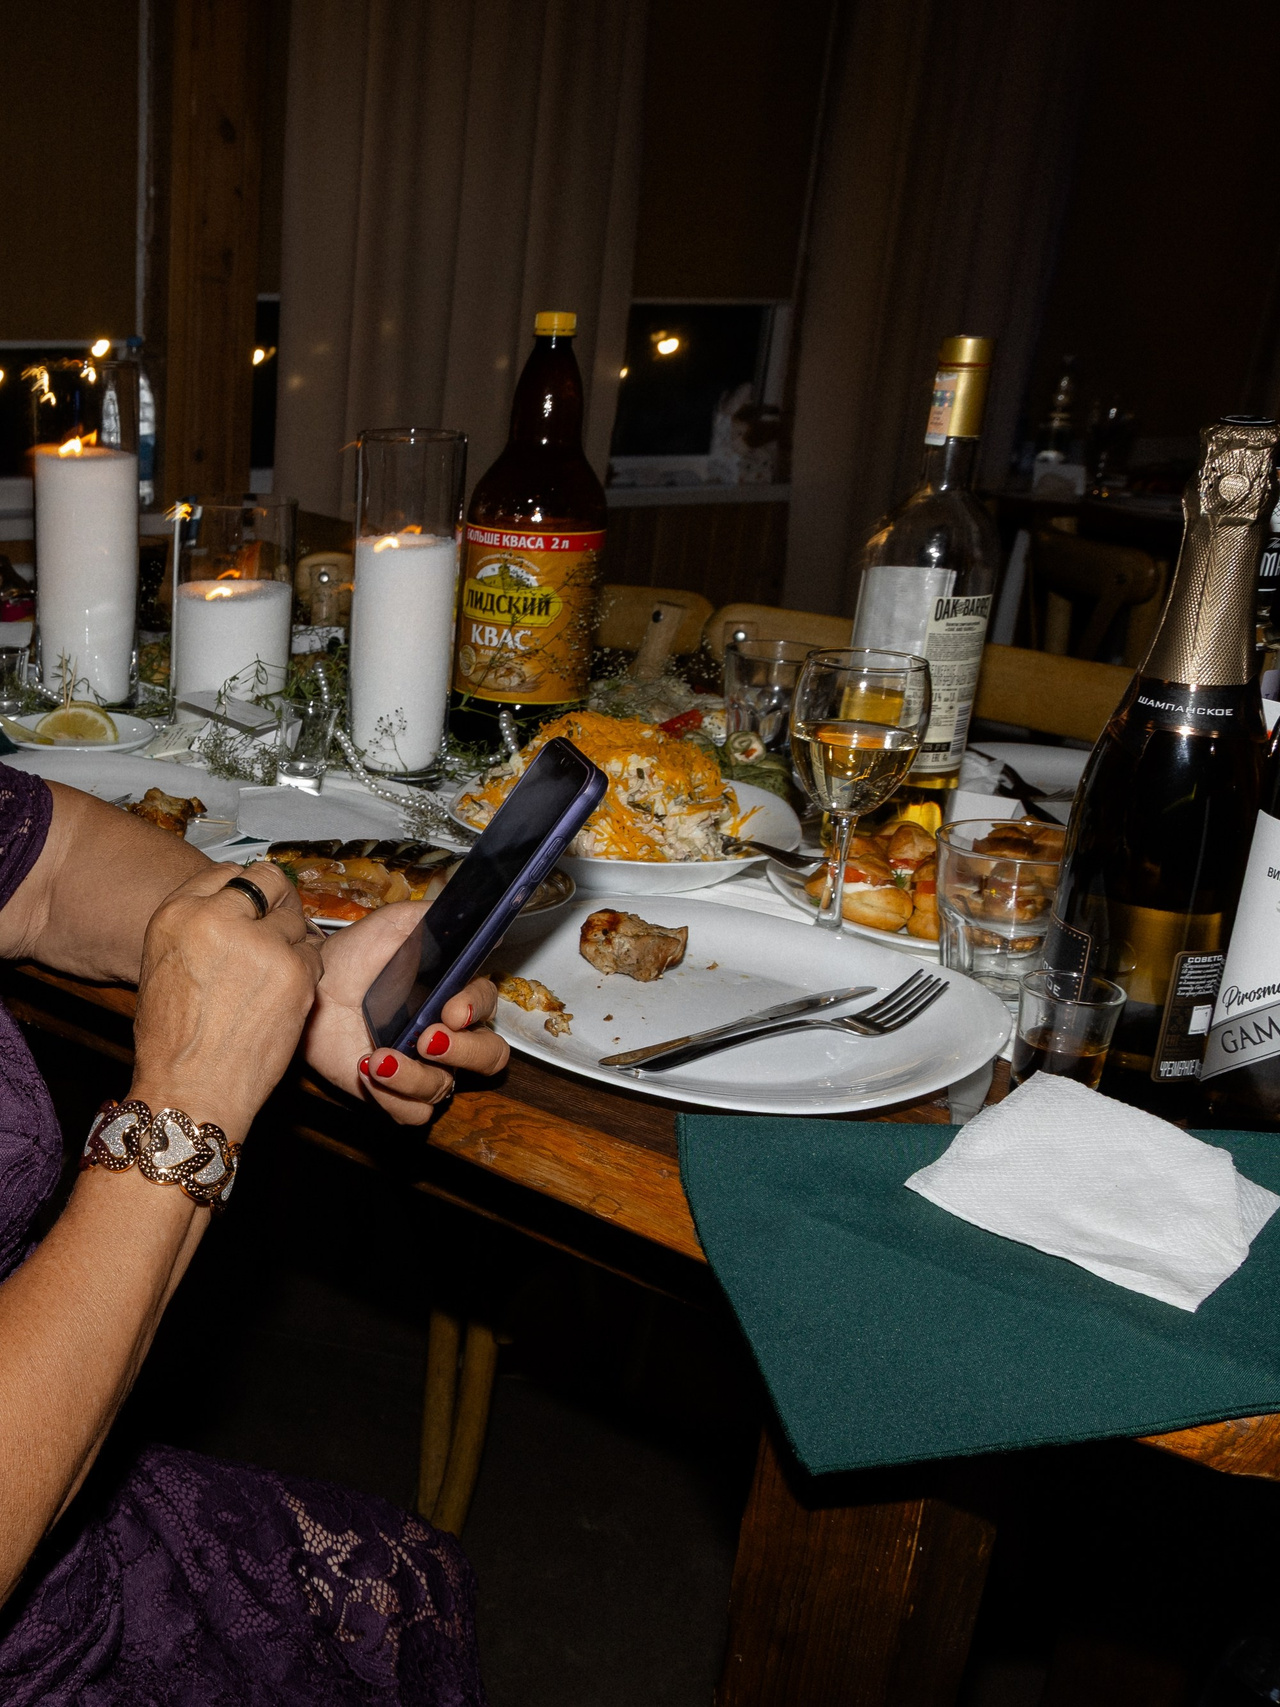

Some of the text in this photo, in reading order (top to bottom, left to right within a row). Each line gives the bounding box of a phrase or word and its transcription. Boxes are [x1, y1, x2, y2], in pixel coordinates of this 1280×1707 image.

[502, 534, 545, 549] КВАСА
[550, 537, 559, 549] 2
[466, 588, 551, 616] ЛИДСКИЙ
[934, 598, 959, 621] OAK
[471, 623, 532, 651] КВАС
[1137, 695, 1234, 716] ШАМПАНСКОЕ
